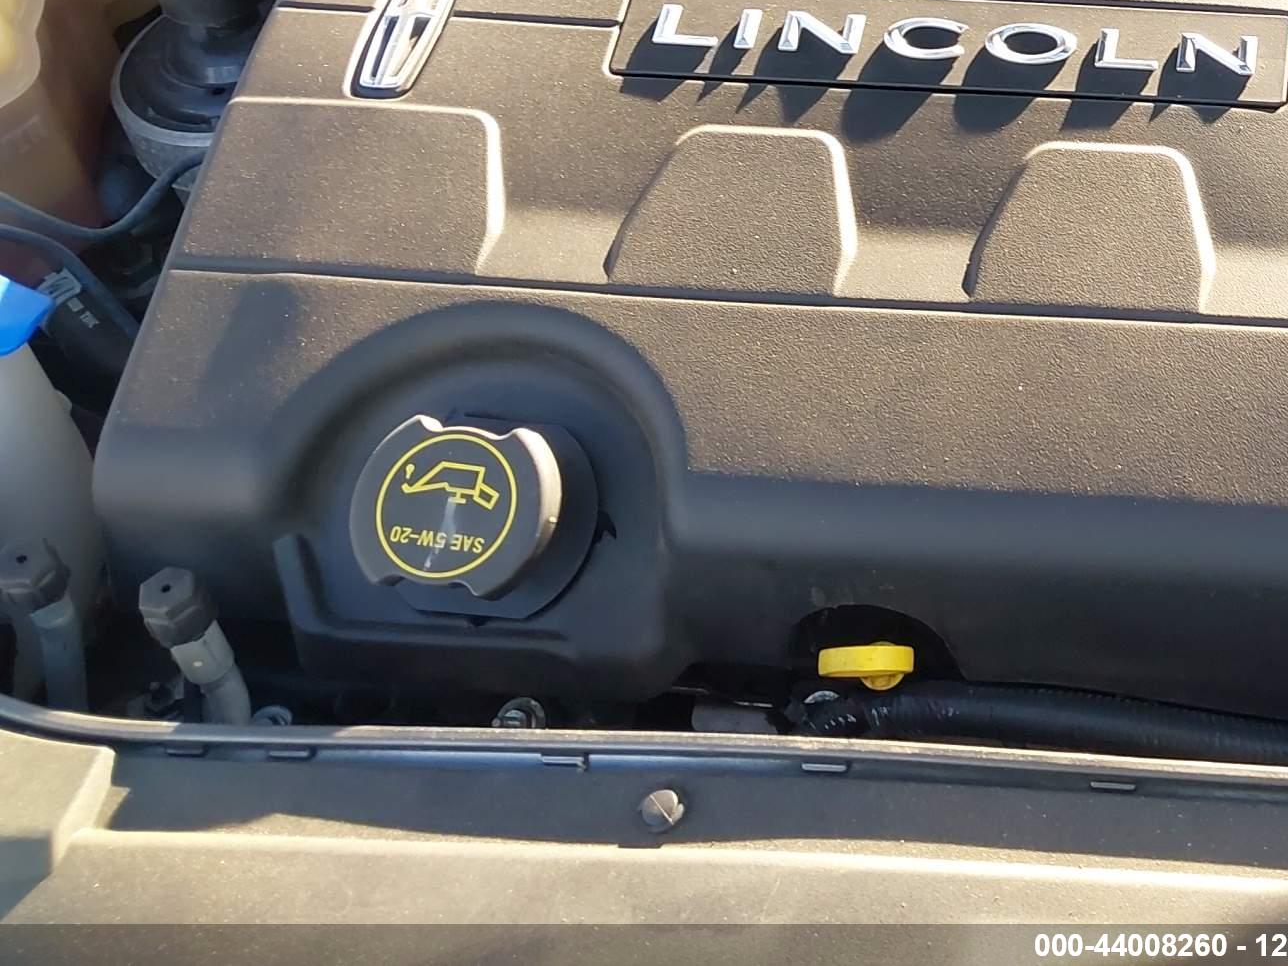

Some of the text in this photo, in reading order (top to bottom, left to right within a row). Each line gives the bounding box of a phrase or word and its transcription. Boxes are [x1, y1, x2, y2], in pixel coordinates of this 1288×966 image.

[651, 3, 1259, 76] LINCOLN
[390, 526, 485, 554] SAE 5W-20
